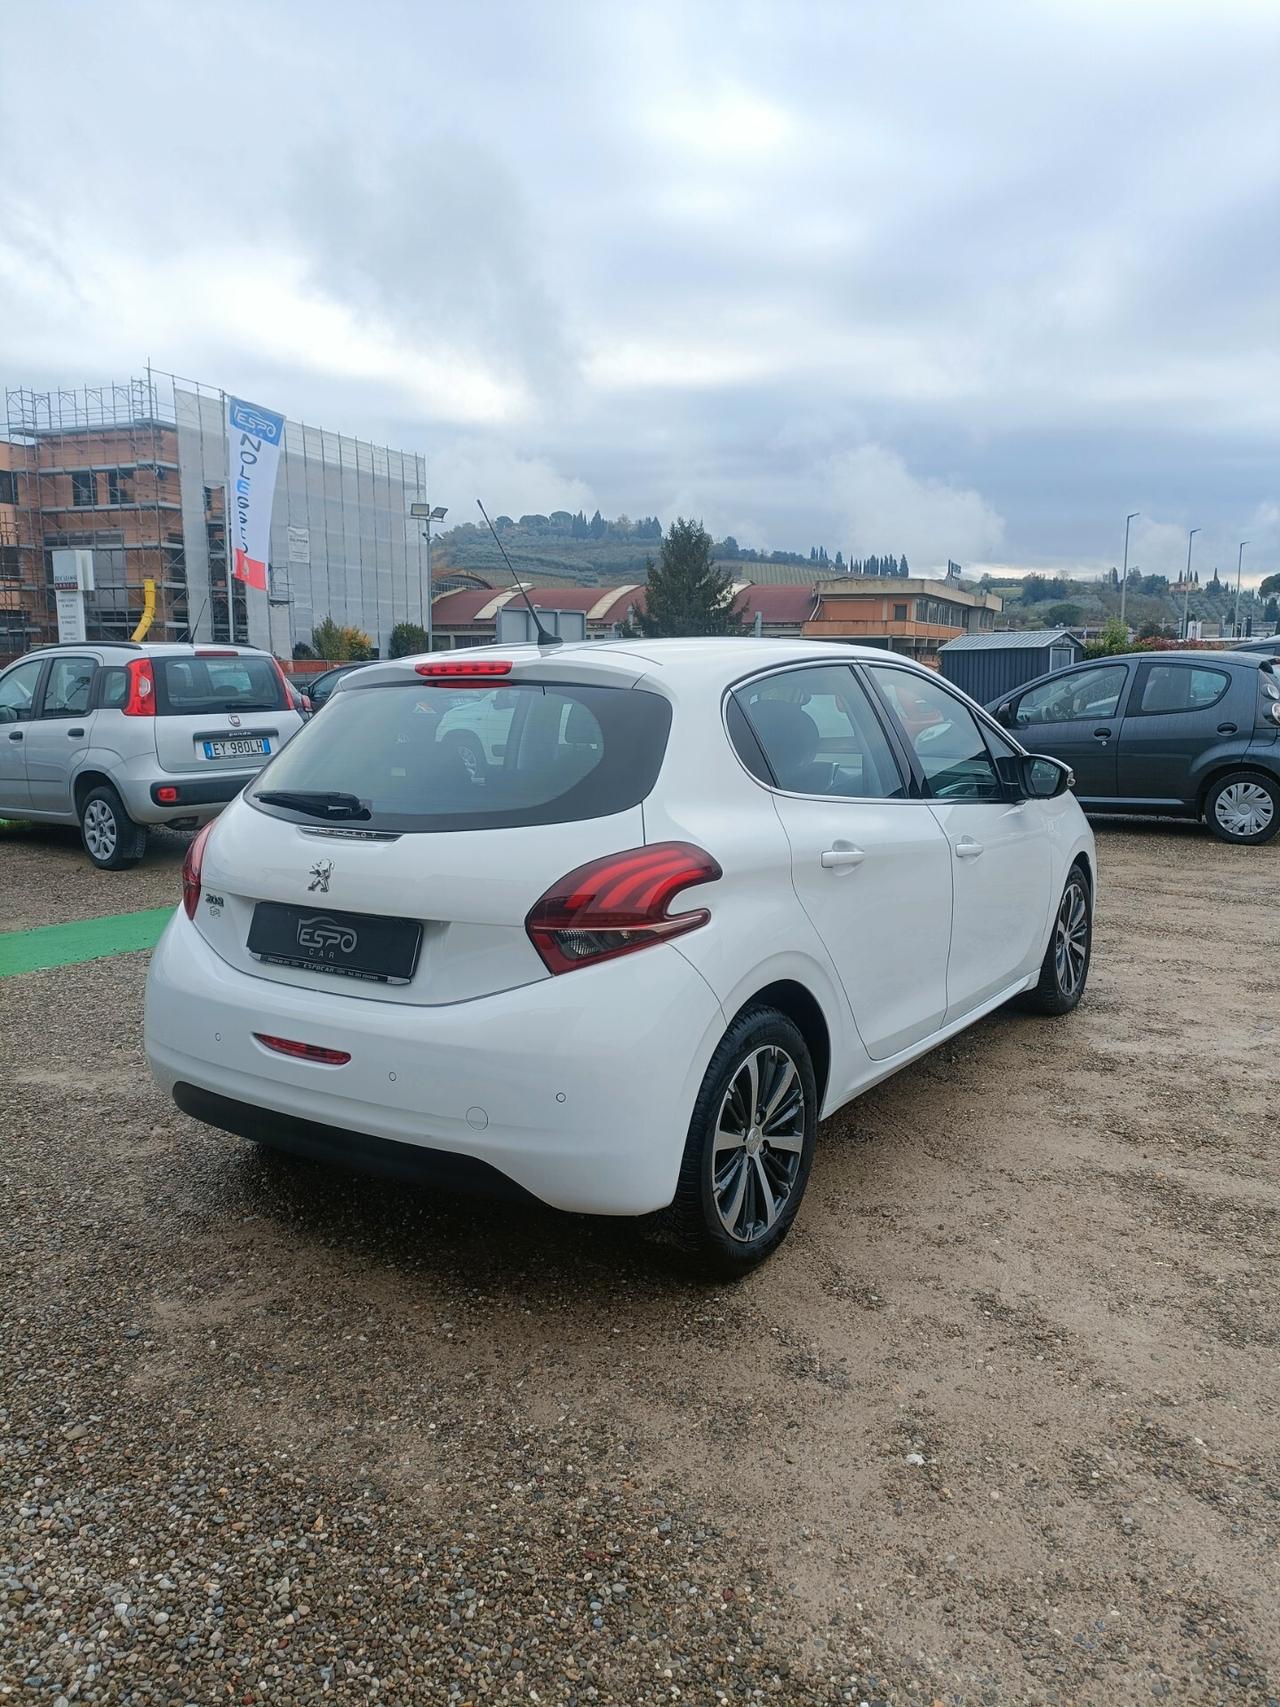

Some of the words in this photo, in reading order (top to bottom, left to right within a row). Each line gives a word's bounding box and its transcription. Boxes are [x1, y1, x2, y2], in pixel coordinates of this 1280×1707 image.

[236, 412, 276, 437] ESPO
[213, 742, 226, 755] EY
[230, 740, 264, 754] 980LH
[299, 928, 357, 953] ESPO
[308, 948, 335, 959] CAR
